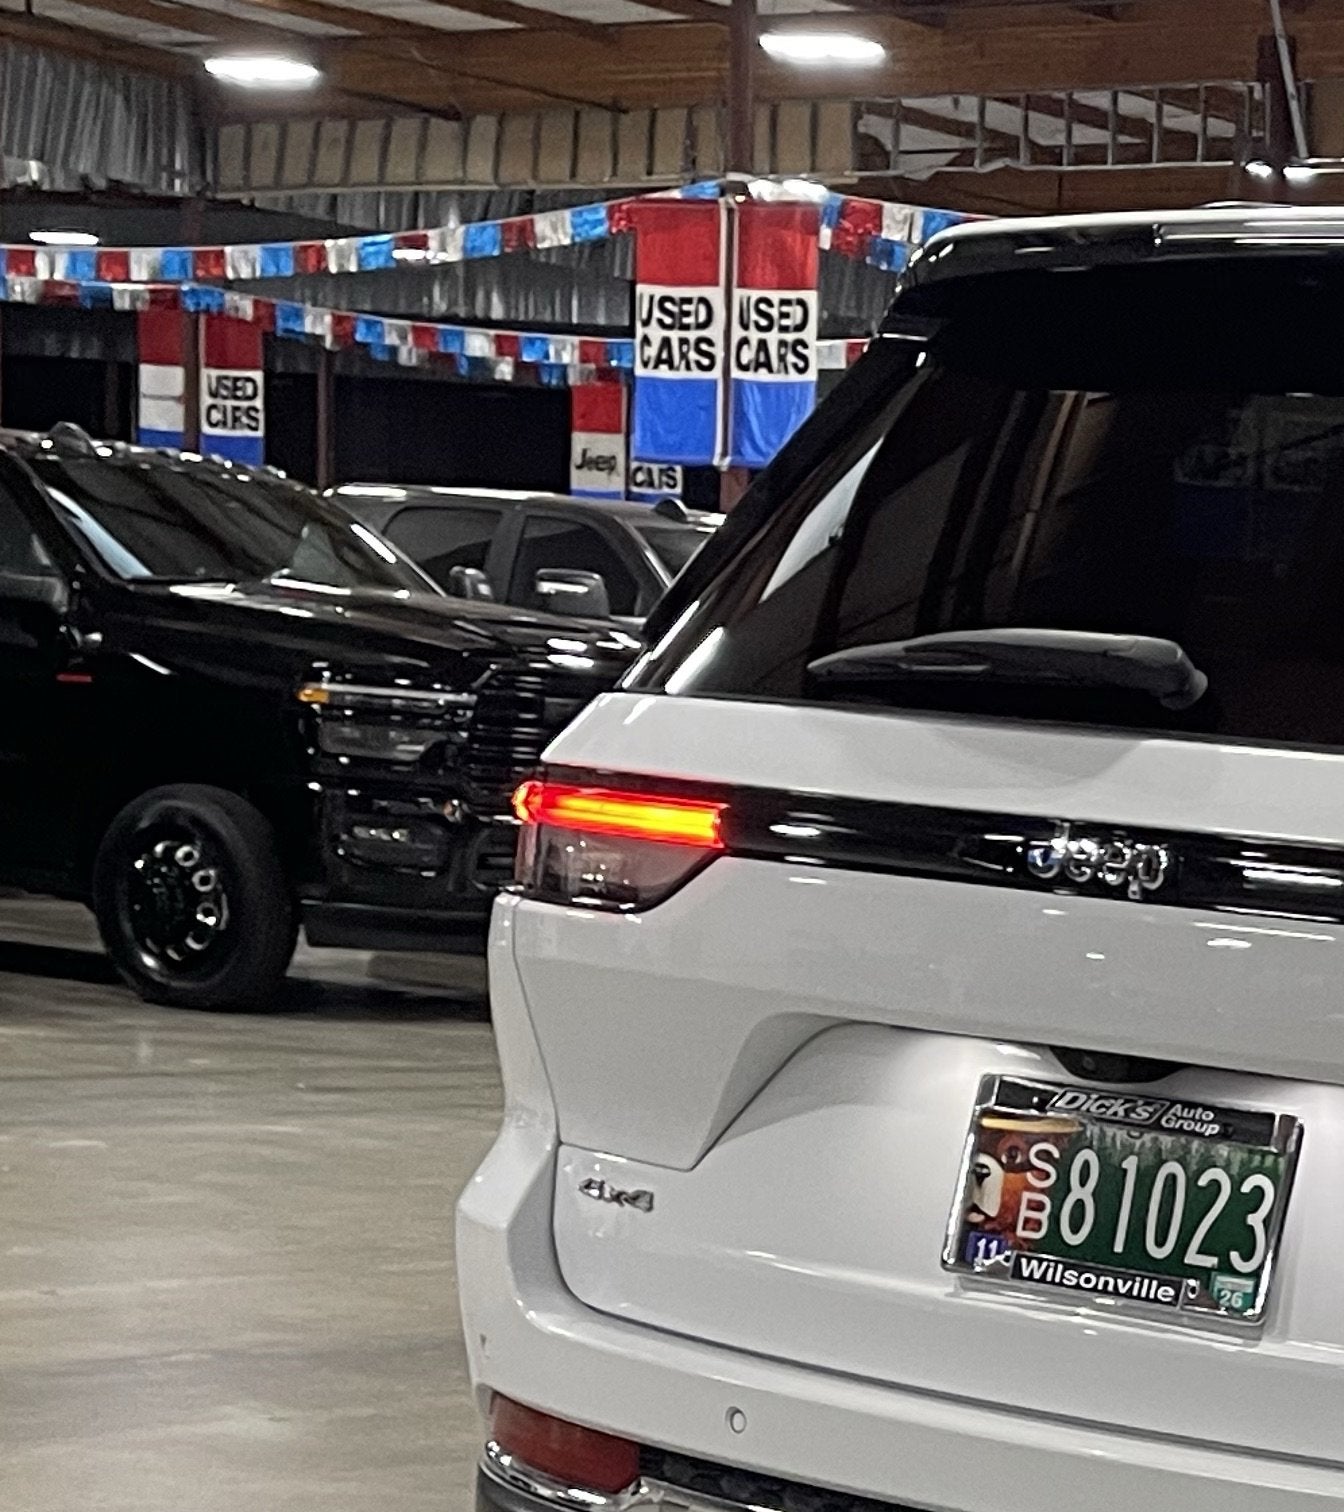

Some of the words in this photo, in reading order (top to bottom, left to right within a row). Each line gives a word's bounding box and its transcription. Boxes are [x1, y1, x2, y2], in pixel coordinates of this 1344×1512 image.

[639, 293, 714, 332] USED
[739, 295, 809, 334] USED
[639, 334, 717, 373] CARS
[735, 336, 810, 375] CARS
[207, 374, 259, 401] USED
[1054, 1091, 1158, 1121] Dick's
[1169, 1103, 1215, 1122] Auto
[1160, 1115, 1221, 1138] Group
[1059, 1148, 1276, 1273] 81023
[1020, 1256, 1177, 1303] Wilsonville
[1219, 1289, 1244, 1308] 26
